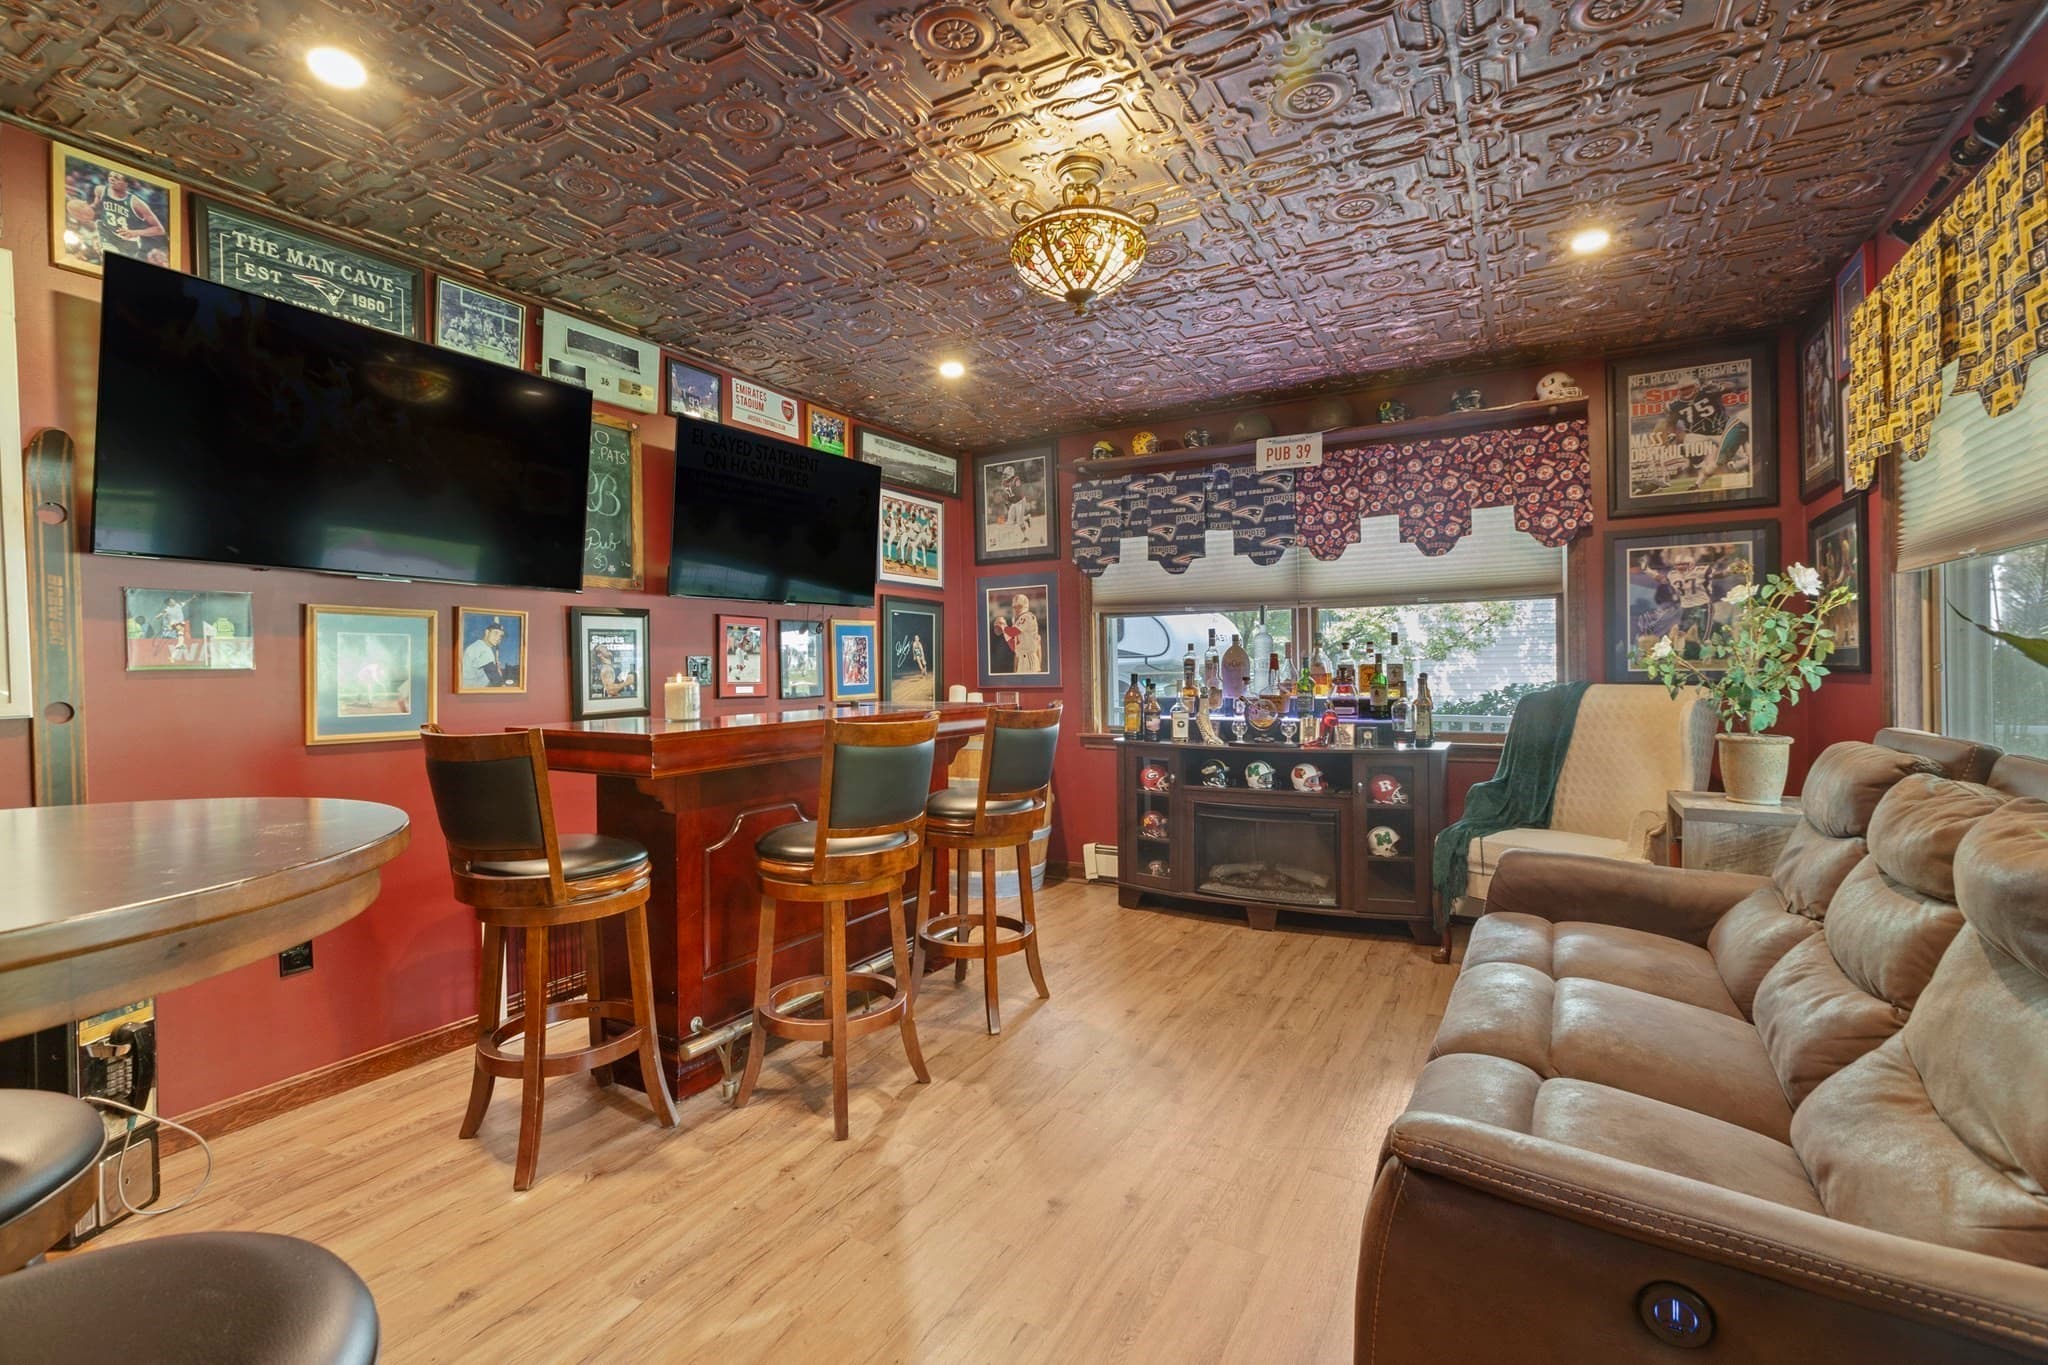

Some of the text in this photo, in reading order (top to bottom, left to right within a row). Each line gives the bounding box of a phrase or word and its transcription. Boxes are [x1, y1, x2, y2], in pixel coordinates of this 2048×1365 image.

[103, 201, 129, 217] CELTICS
[106, 212, 129, 229] 34
[232, 231, 396, 293] THE MAN CAVE
[244, 262, 283, 284] EST
[352, 294, 386, 313] 1960
[1698, 362, 1747, 378] PREVIEW
[600, 376, 610, 386] 36
[736, 383, 767, 402] EMIRATES
[736, 394, 764, 411] STADIUM
[1679, 397, 1715, 421] 75
[1631, 431, 1664, 449] MASS
[692, 427, 819, 473] EL SAYED STATEMENT
[1266, 444, 1311, 462] PUB 39
[704, 451, 726, 470] ON
[731, 457, 776, 481] HASAN
[779, 469, 809, 488] PIKER
[591, 635, 625, 644] Sports
[1378, 780, 1393, 792] R
